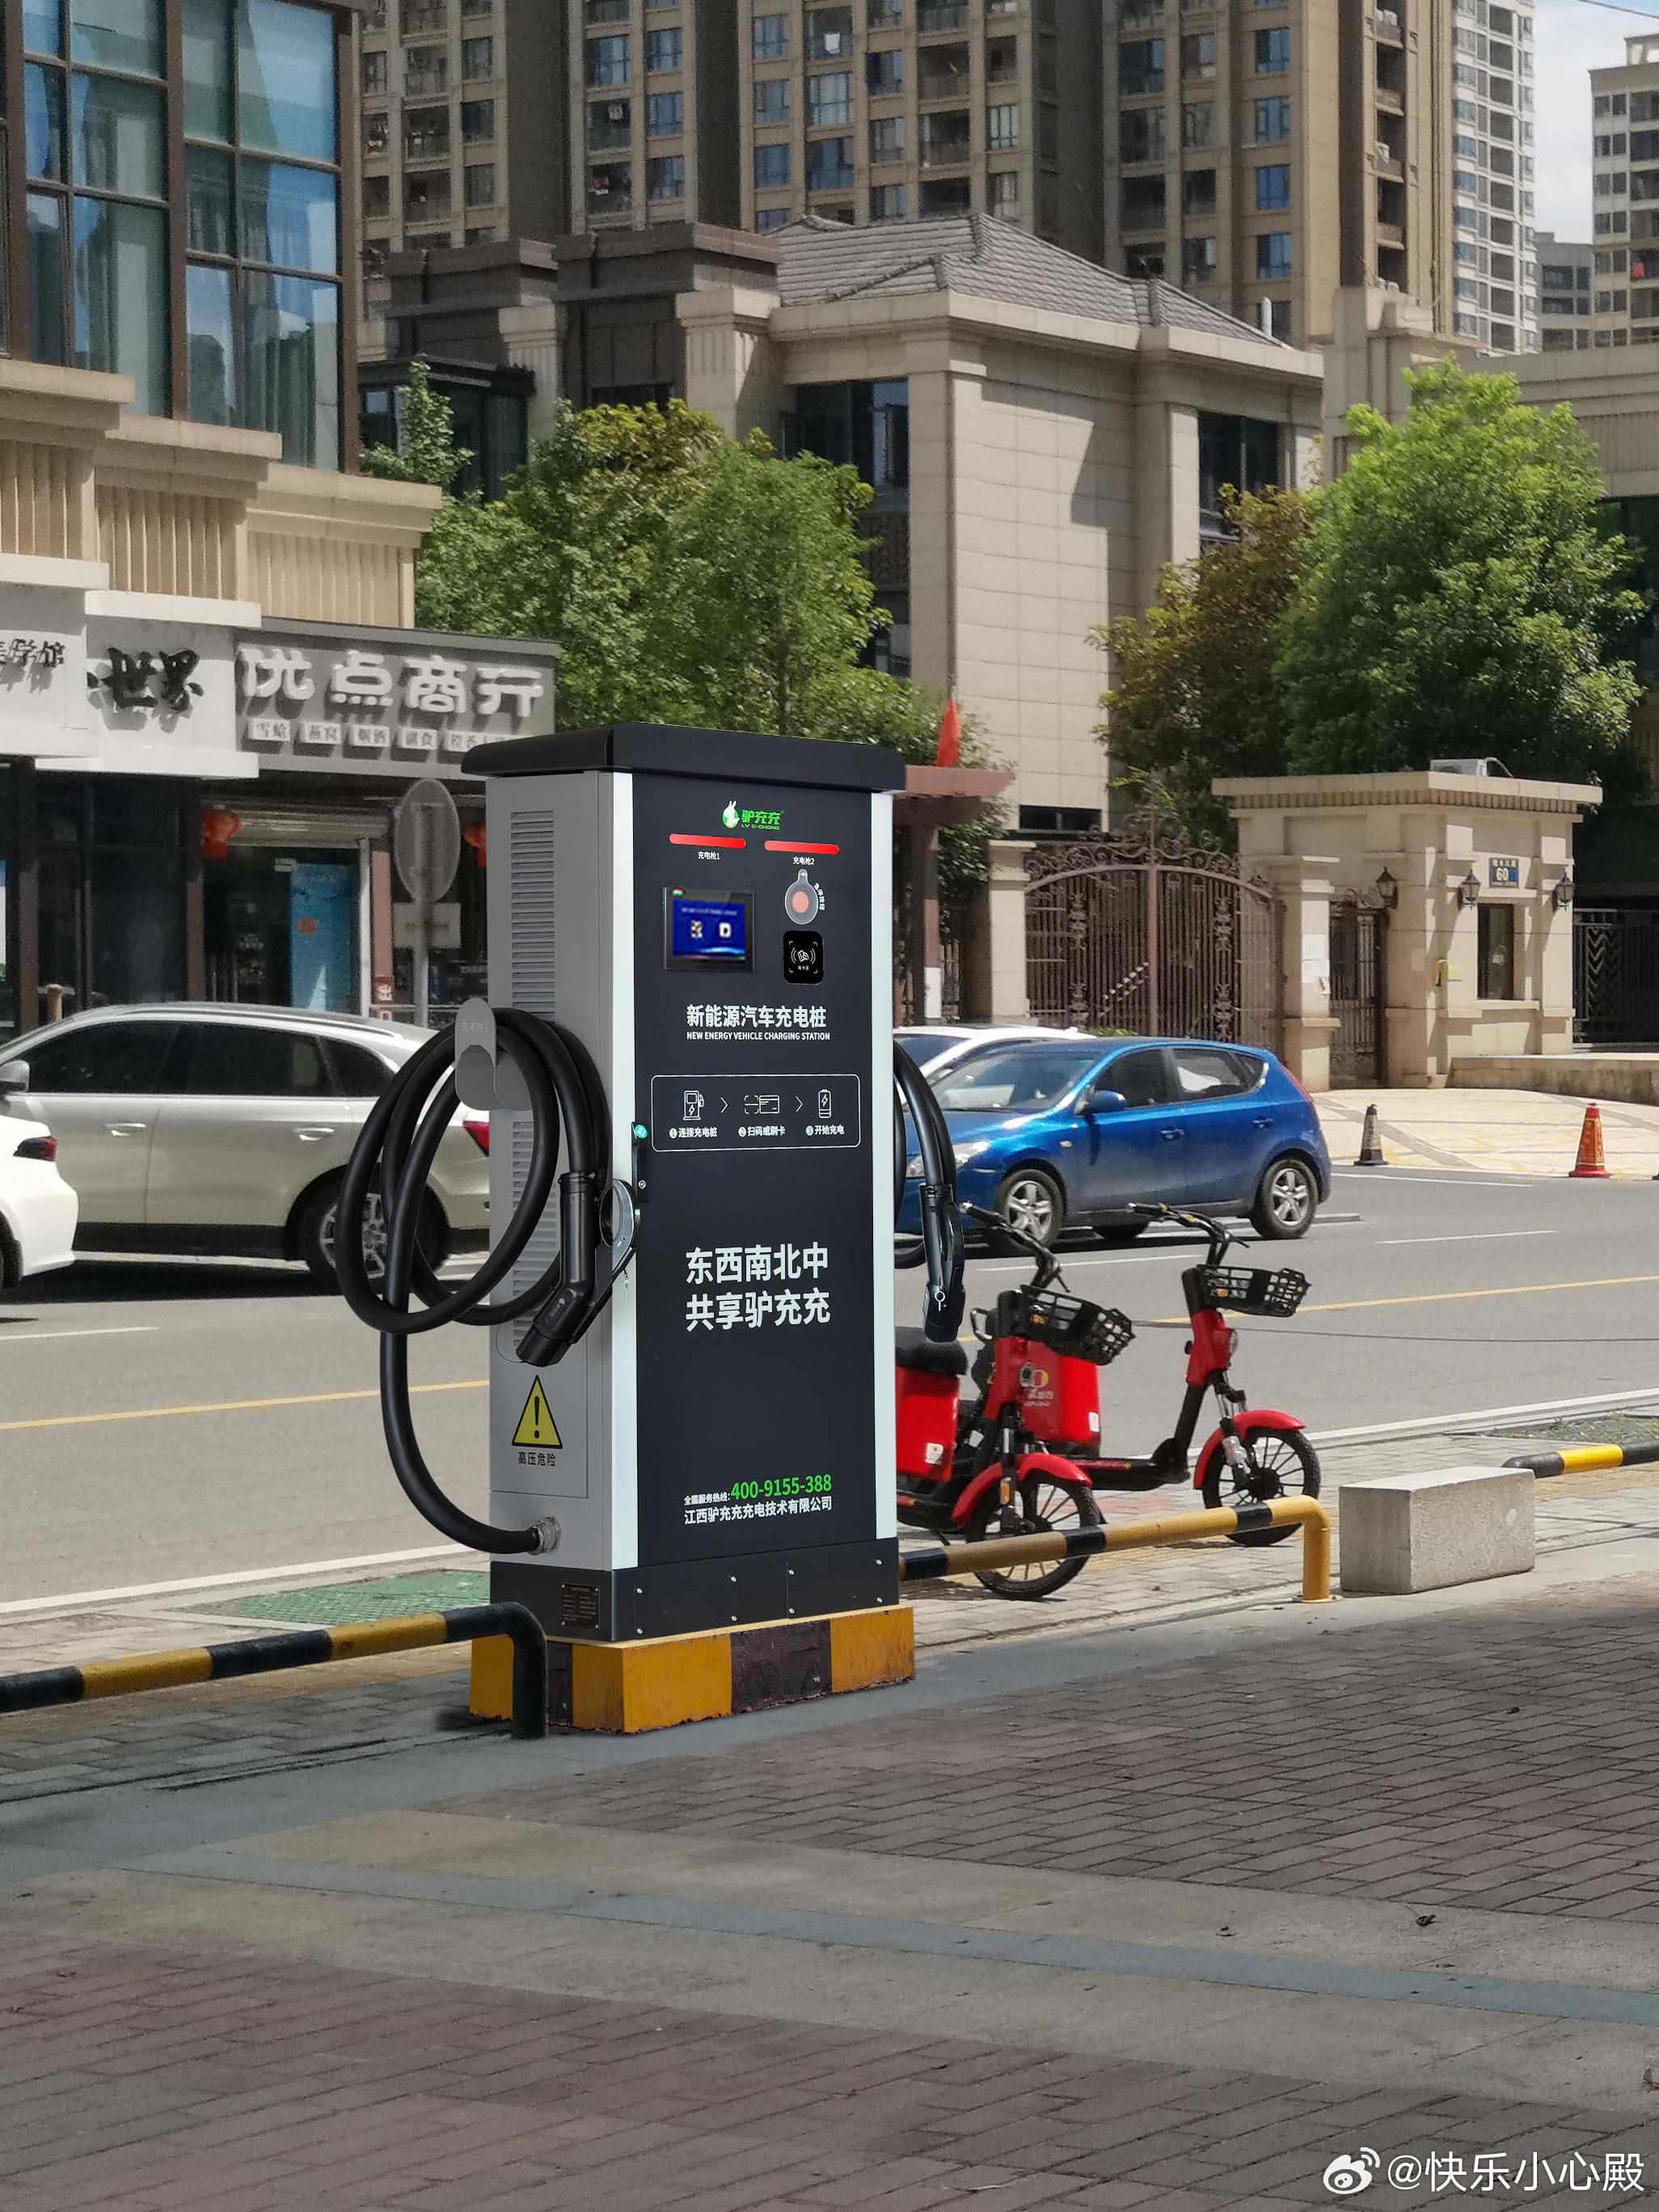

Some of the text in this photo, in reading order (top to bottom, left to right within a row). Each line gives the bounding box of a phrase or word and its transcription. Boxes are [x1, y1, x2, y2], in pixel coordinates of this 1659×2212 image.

[87, 648, 205, 712] 世界
[239, 646, 544, 718] 优点商行
[741, 809, 781, 825] 驴充充
[698, 851, 720, 860] 充电枪1
[793, 856, 815, 865] 充电枪2
[686, 1004, 827, 1028] 新能源汽车充电桩
[686, 1031, 830, 1041] NEW ENERGY VEHICLE CHARGING STATION
[686, 1241, 829, 1285] 东西南北中
[686, 1287, 831, 1332] 共享驴充充
[517, 1451, 556, 1467] 高压危险
[684, 1496, 833, 1525] 江西驴充充充电技术有限公司
